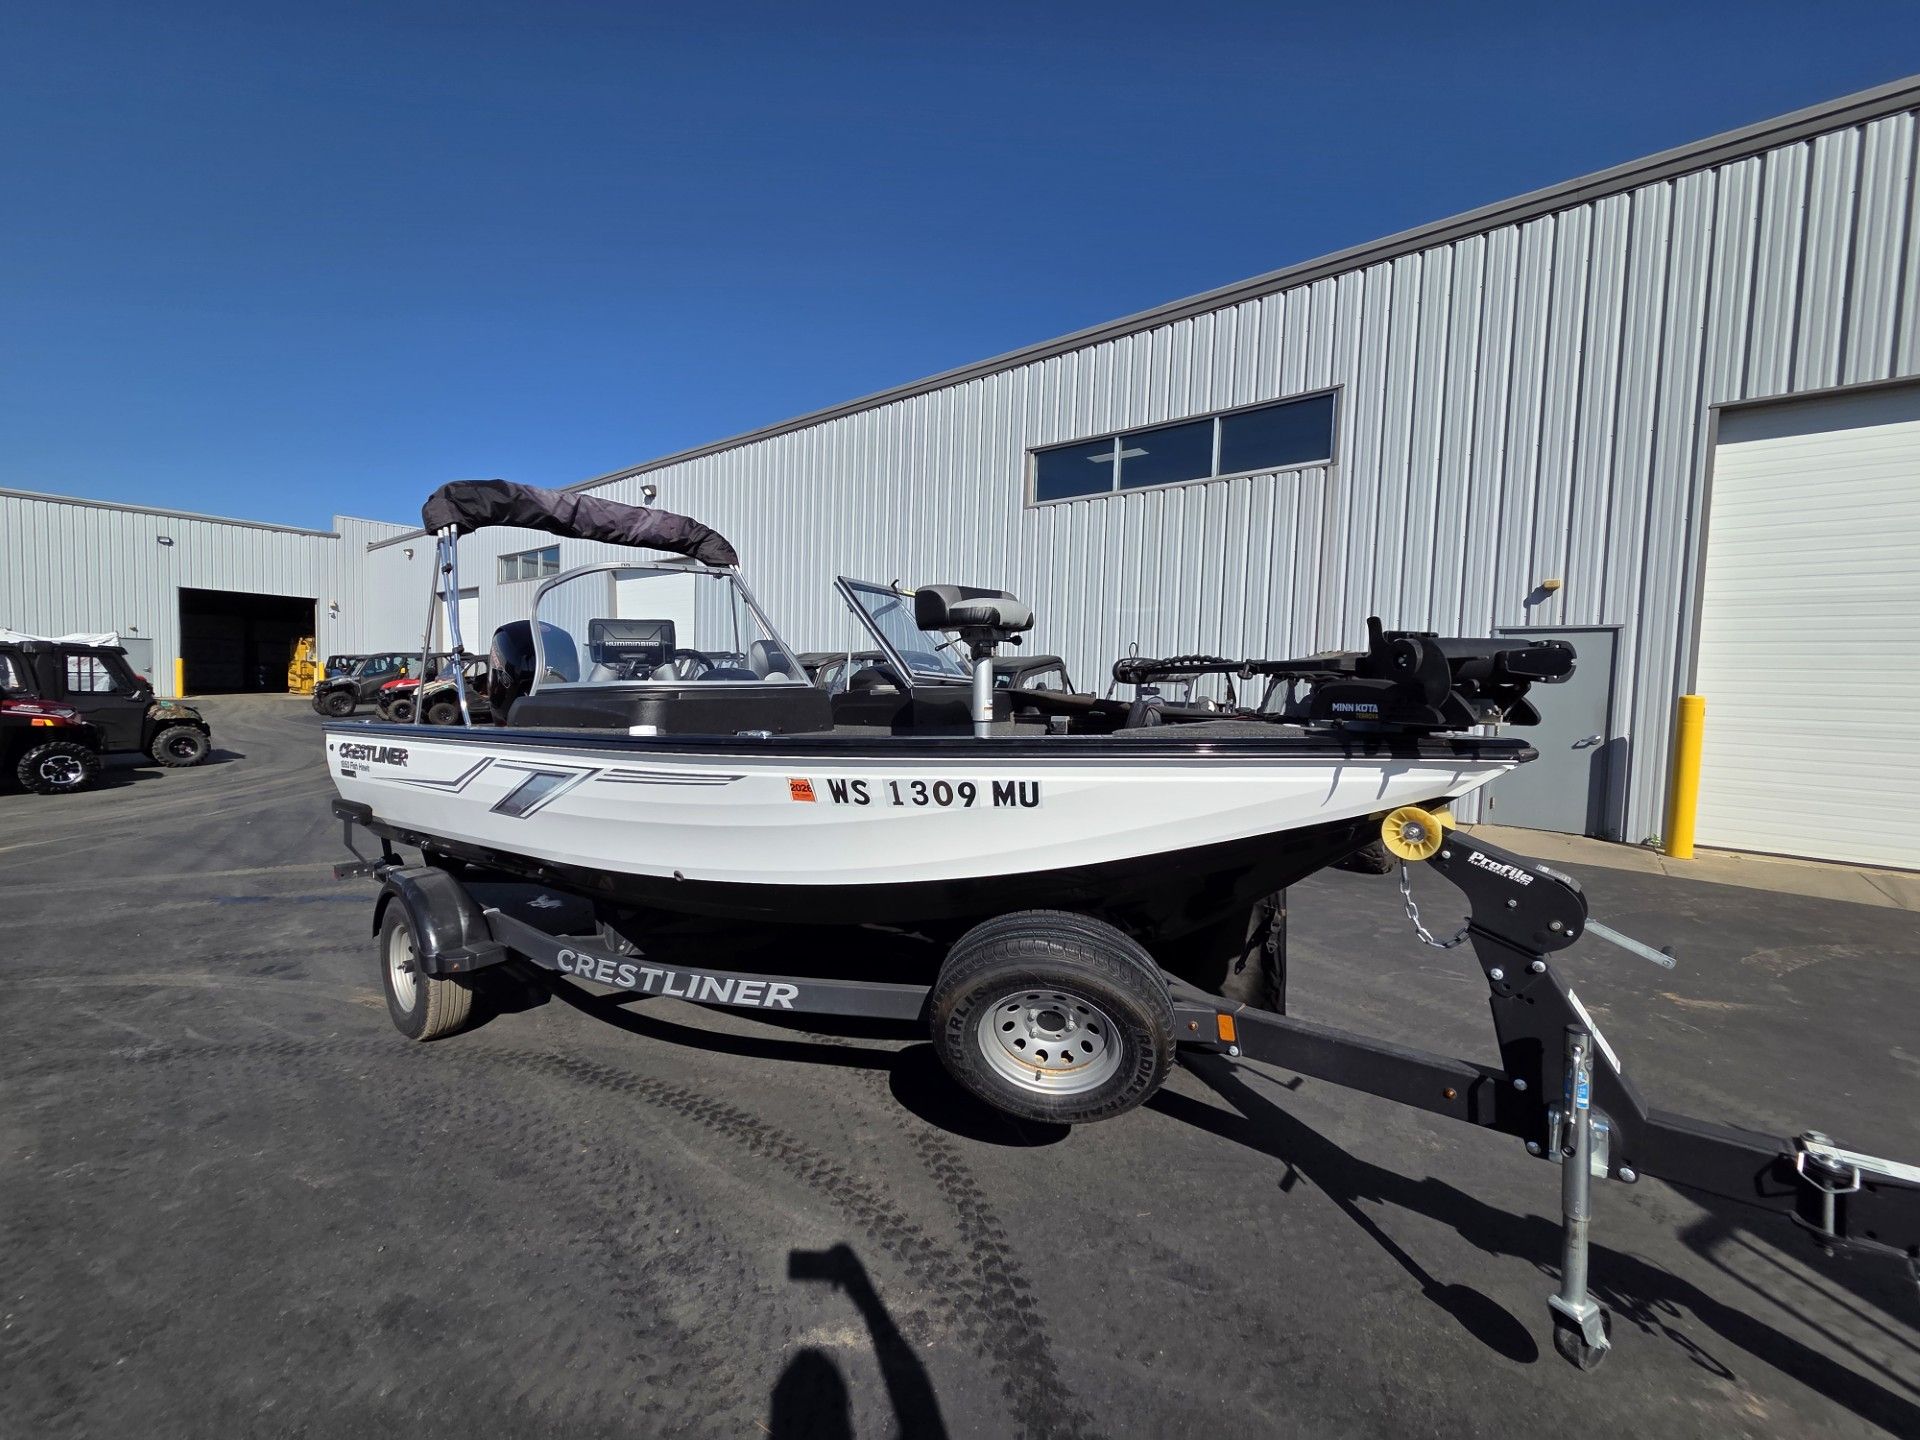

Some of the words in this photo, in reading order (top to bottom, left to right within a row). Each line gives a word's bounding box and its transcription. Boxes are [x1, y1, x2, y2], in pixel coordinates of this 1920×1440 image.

[1332, 703, 1354, 712] MINN
[1355, 704, 1379, 713] KOTA
[339, 742, 409, 767] CRESTLINER
[826, 778, 871, 806] WS
[888, 779, 977, 808] 1309
[992, 780, 1039, 808] MU
[1468, 851, 1534, 882] Profile
[556, 949, 799, 1009] CRESTLINER
